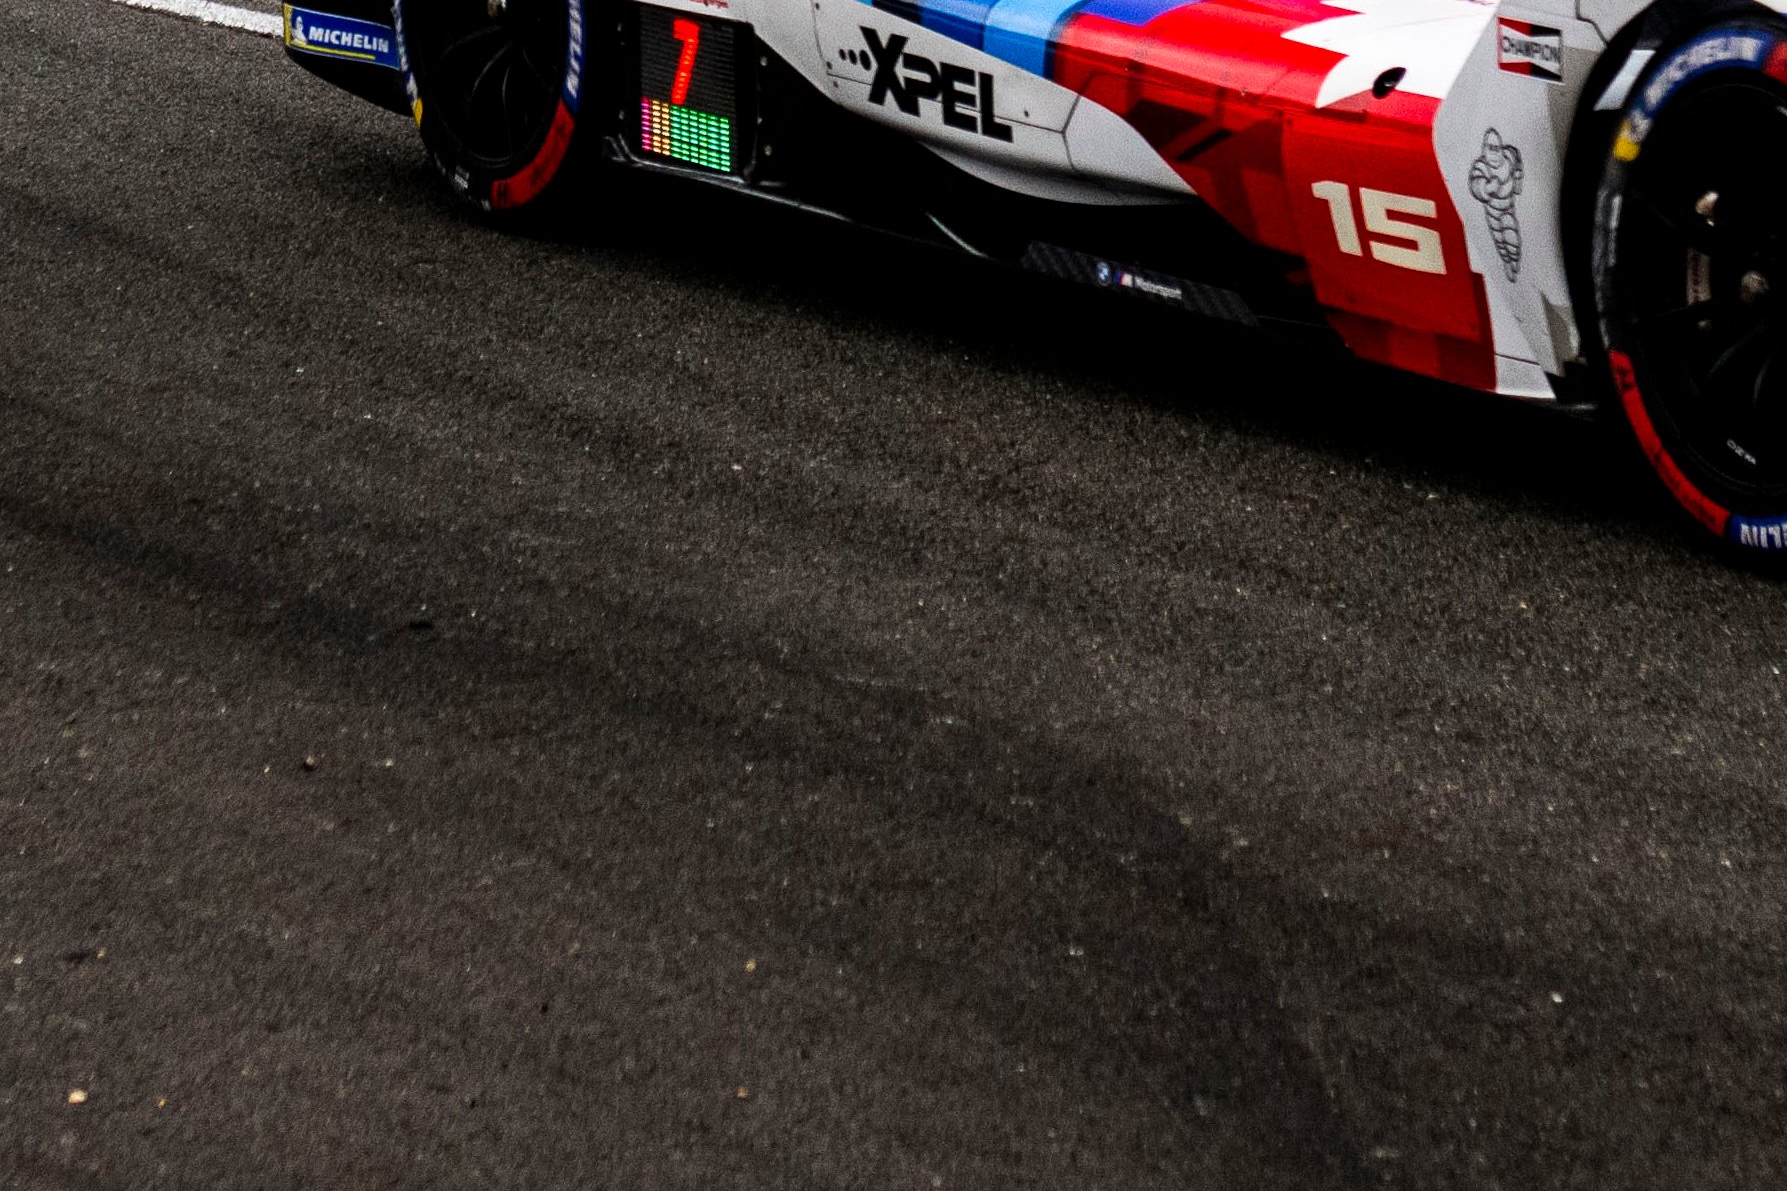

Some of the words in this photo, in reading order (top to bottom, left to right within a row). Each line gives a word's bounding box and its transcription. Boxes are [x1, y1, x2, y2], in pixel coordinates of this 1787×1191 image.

[307, 25, 391, 54] MICHELIN
[1501, 35, 1562, 64] CHAMPION
[858, 25, 1014, 144] XPEL
[1310, 179, 1447, 275] 15
